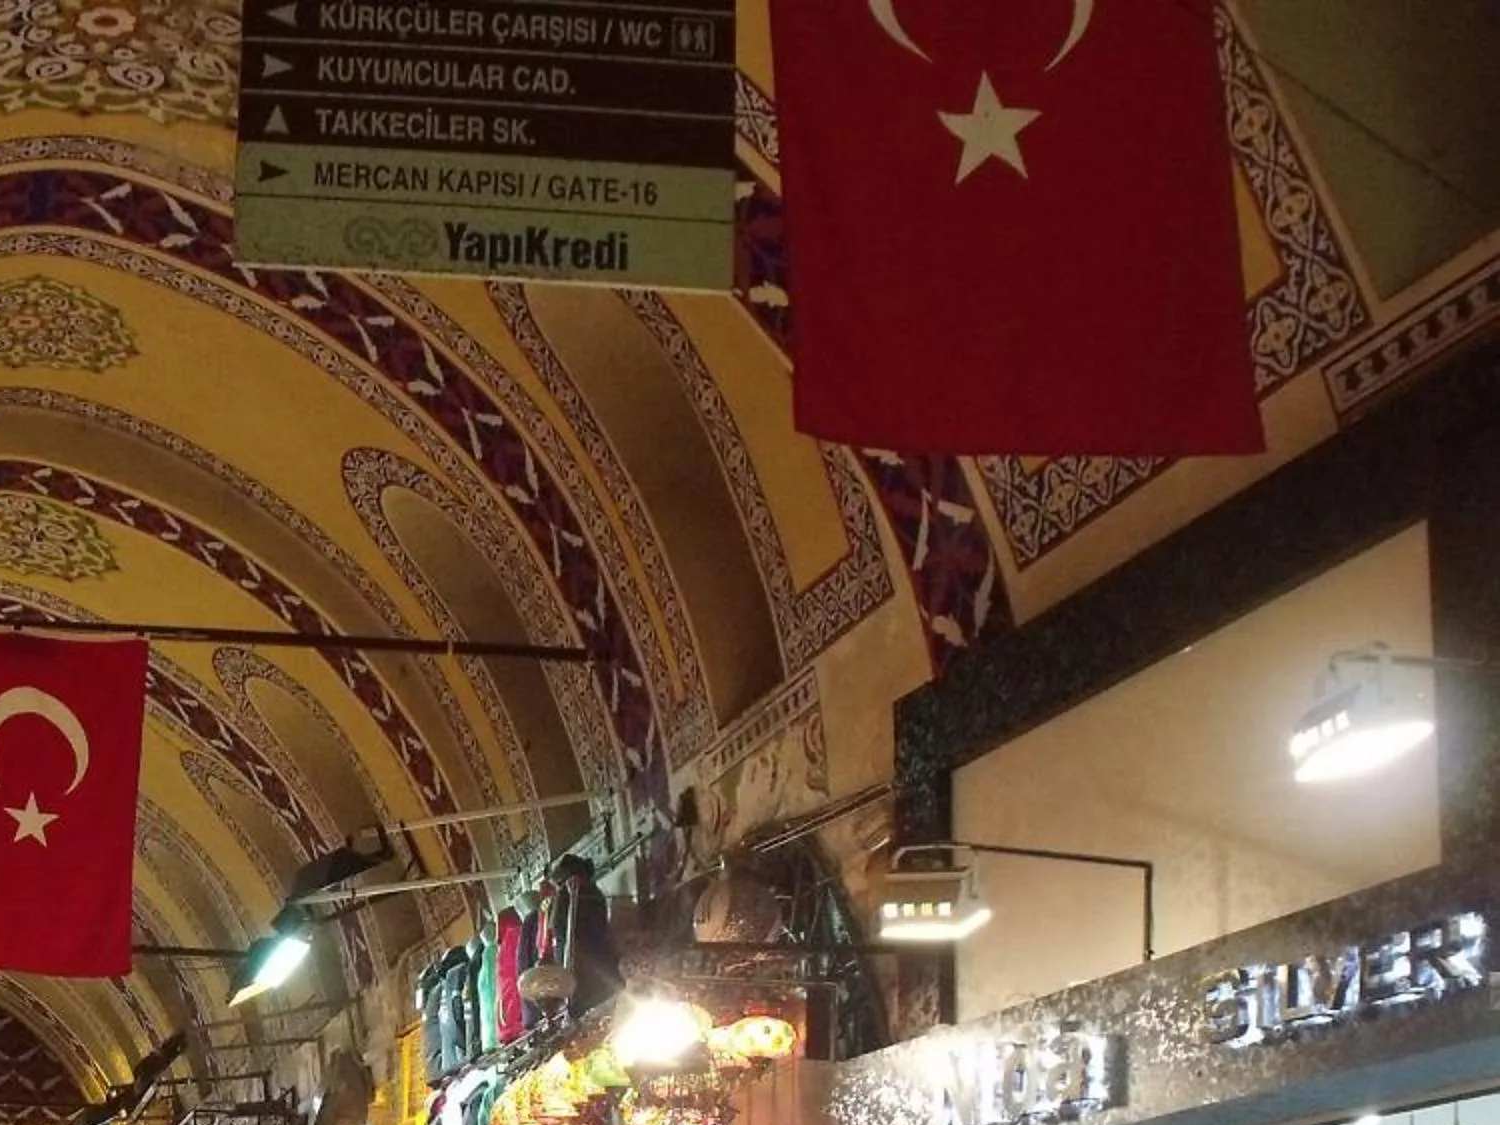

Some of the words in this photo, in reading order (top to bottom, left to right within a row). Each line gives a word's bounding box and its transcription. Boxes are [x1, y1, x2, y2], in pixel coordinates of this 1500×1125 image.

[492, 12, 597, 48] ÇARŞISI
[603, 18, 614, 44] /
[619, 20, 663, 47] WC
[318, 55, 504, 90] KUYUMCULAR
[512, 65, 577, 95] CAD.
[315, 106, 486, 142] TAKKECİLER
[493, 117, 536, 145] SK.
[314, 161, 429, 191] MERCAN
[437, 168, 525, 198] KAPISI
[530, 173, 542, 197] /
[548, 175, 659, 207] GATE-16
[444, 220, 629, 272] YapıKredi
[1197, 911, 1487, 1050] SILVER
